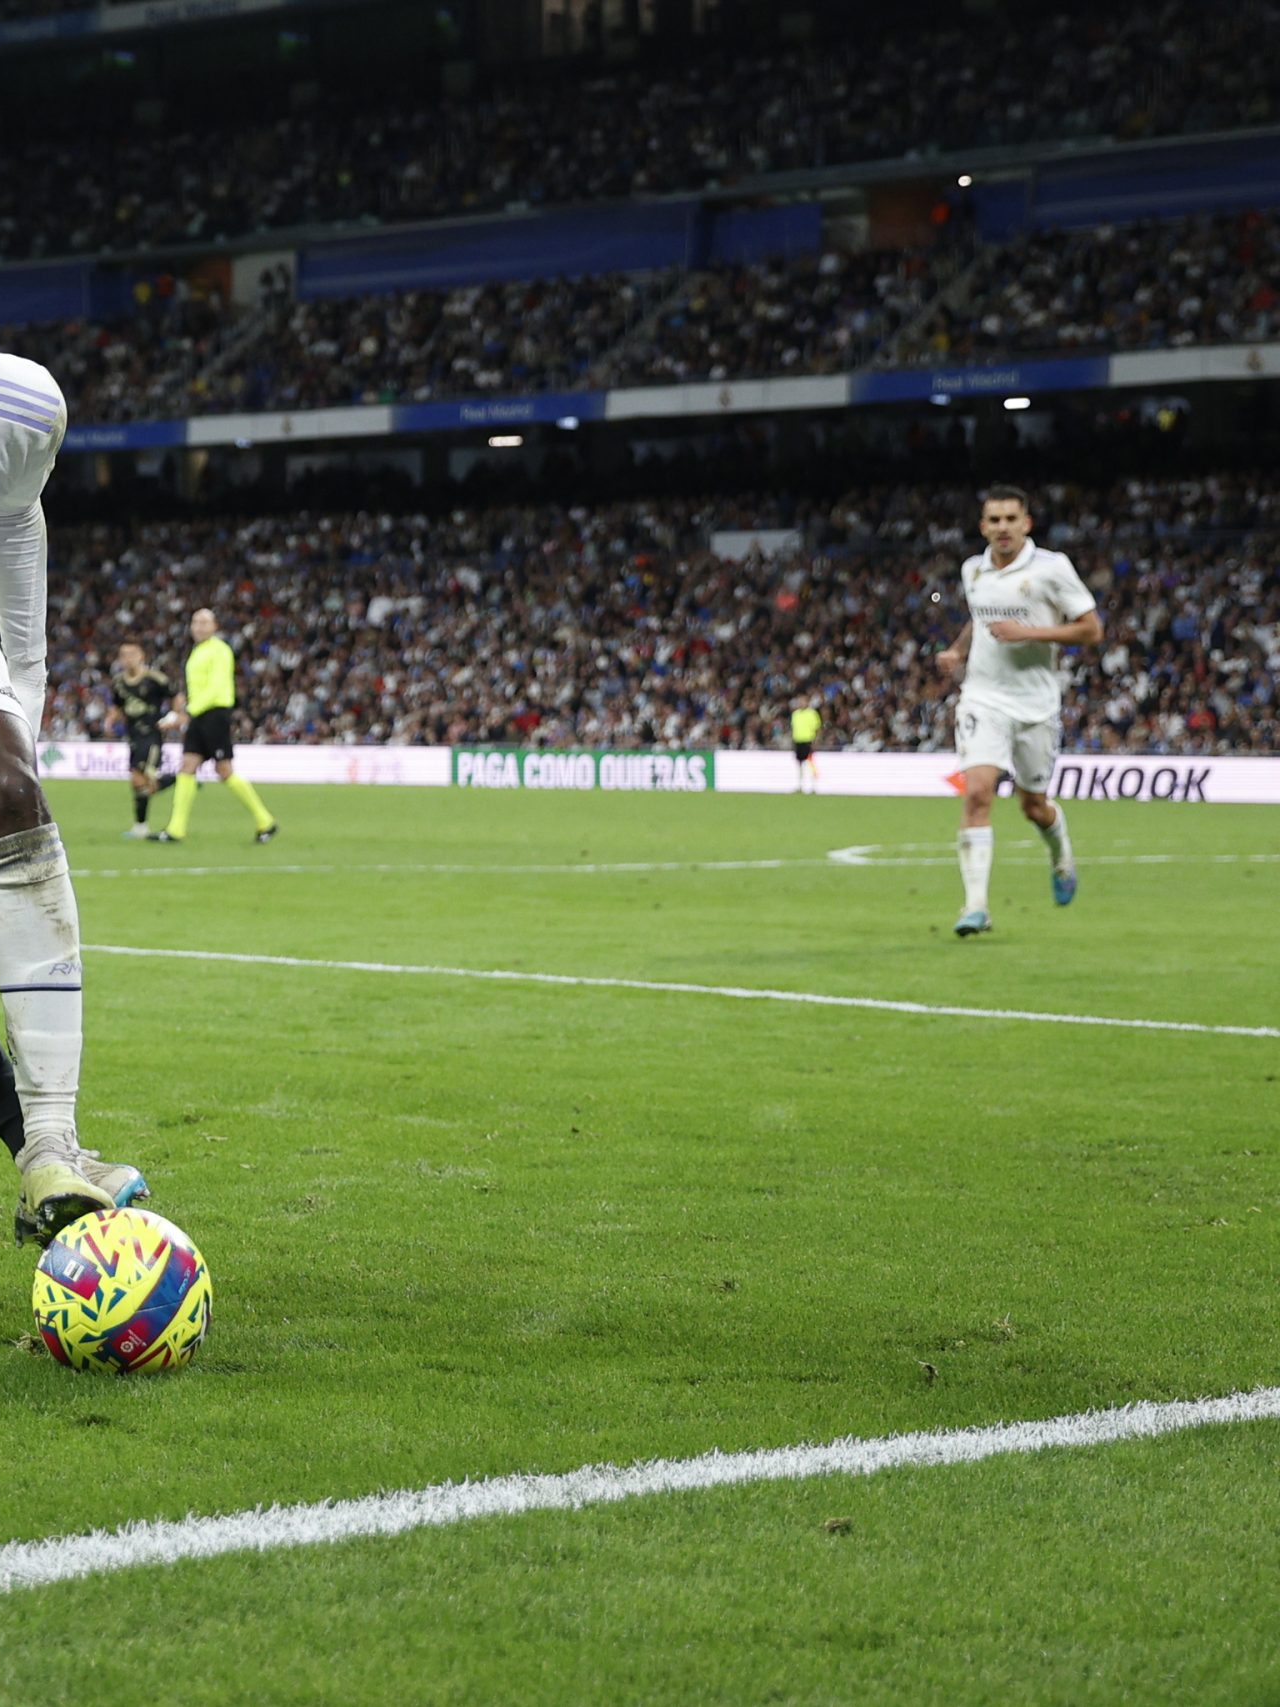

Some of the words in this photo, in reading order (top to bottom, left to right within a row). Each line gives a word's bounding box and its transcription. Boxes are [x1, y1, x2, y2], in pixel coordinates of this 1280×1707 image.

[457, 752, 520, 788] PAGA
[523, 753, 596, 789] COMO
[599, 754, 707, 791] QUIERAS
